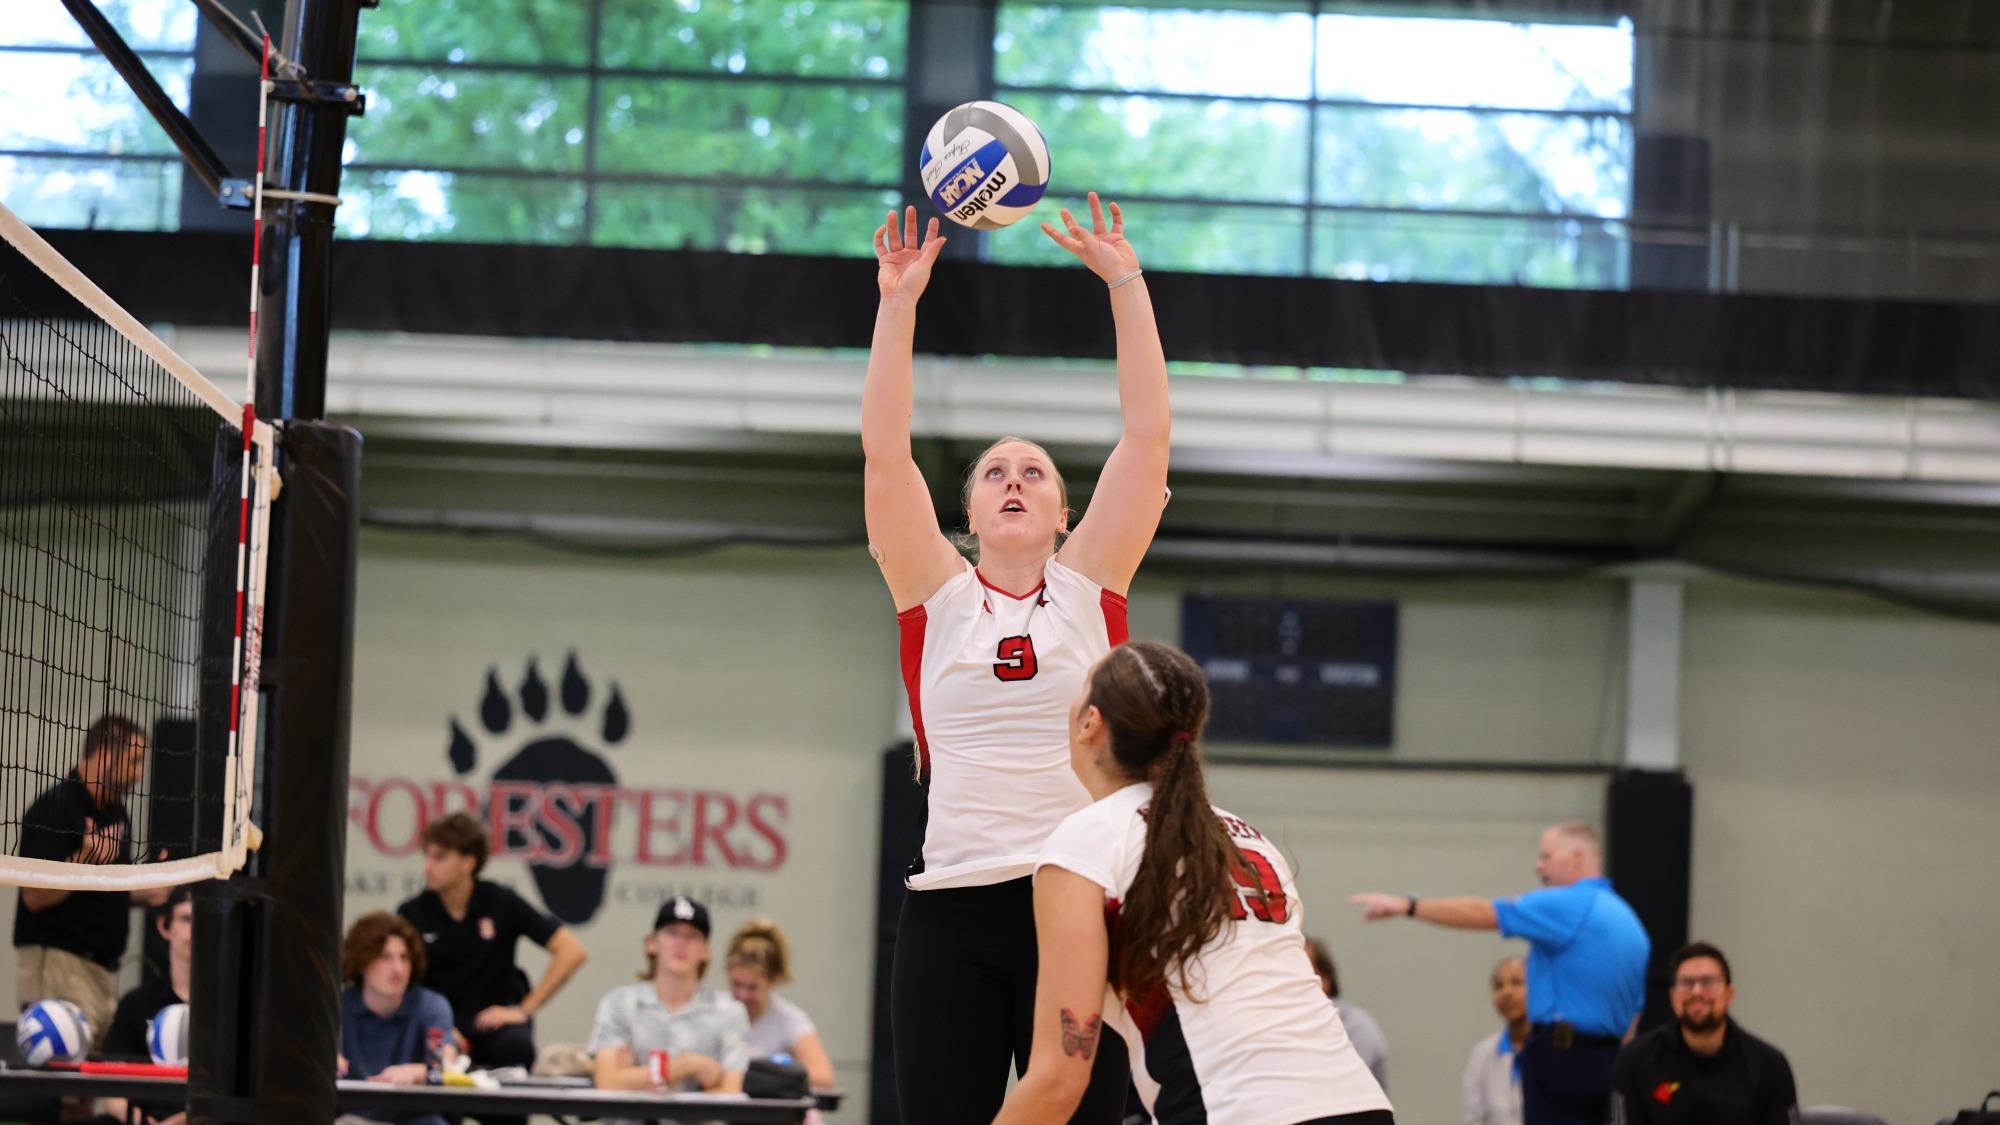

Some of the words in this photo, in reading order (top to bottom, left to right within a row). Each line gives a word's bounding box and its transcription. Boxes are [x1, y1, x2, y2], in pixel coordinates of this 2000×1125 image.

[938, 158, 986, 208] NCAA
[953, 171, 1007, 221] molten
[993, 633, 1039, 683] 9
